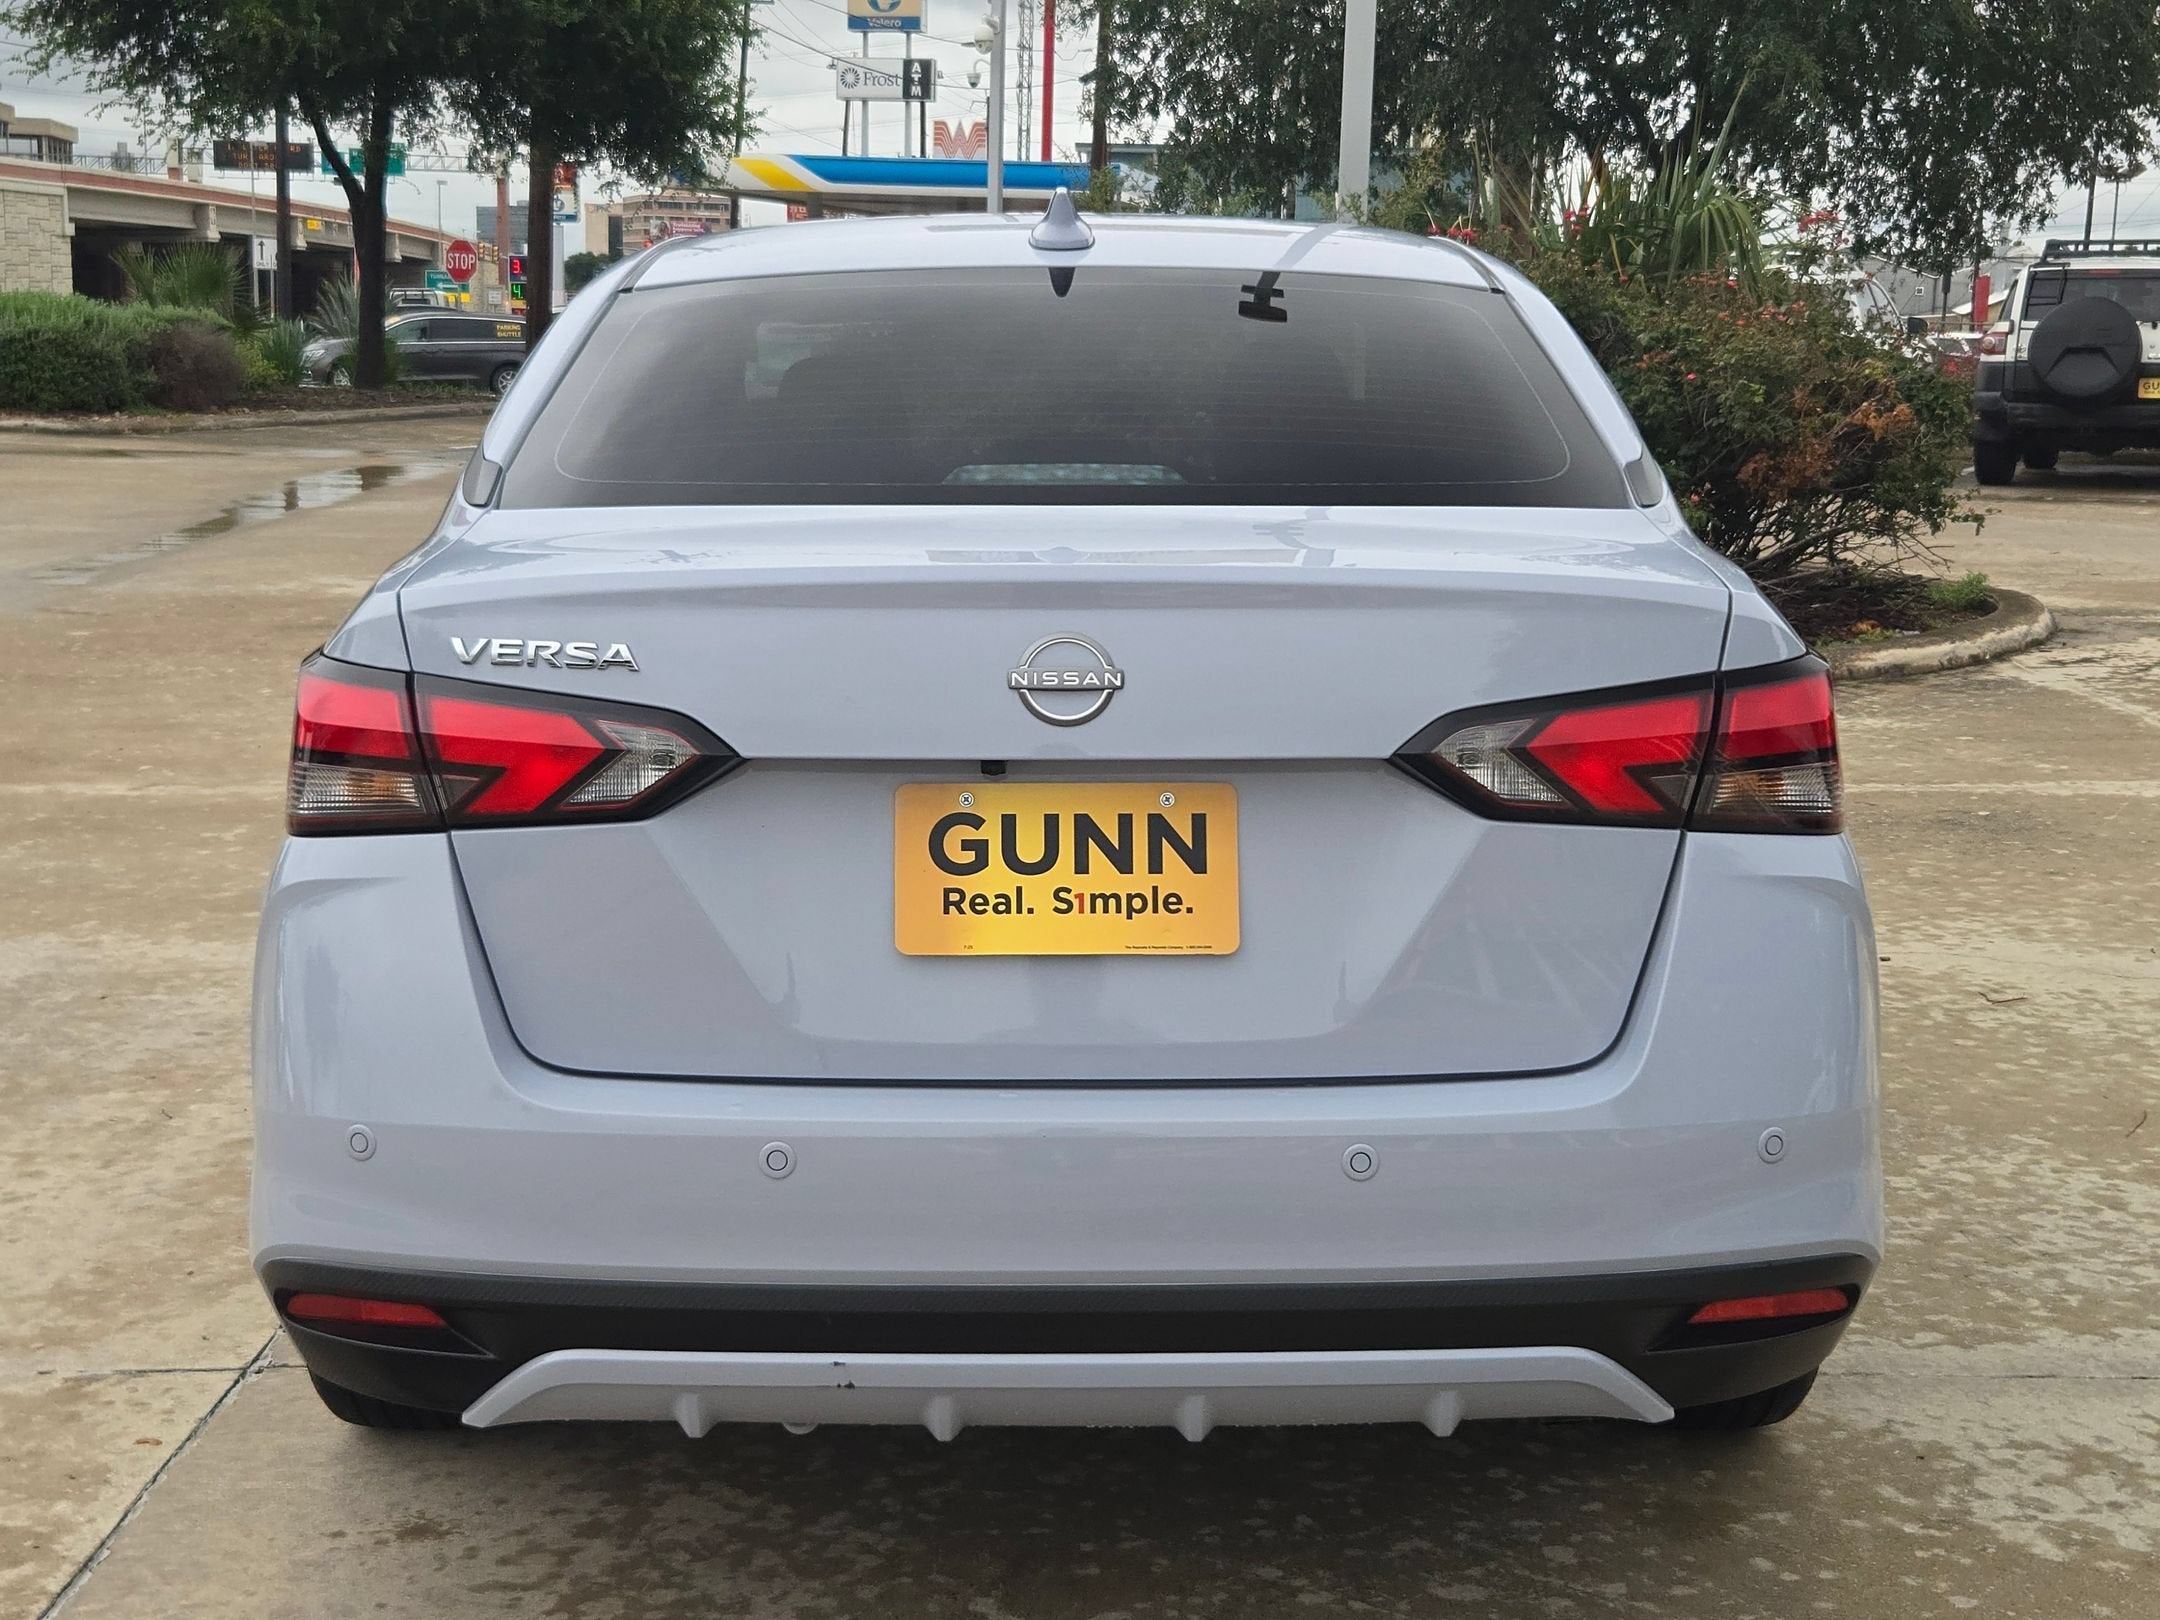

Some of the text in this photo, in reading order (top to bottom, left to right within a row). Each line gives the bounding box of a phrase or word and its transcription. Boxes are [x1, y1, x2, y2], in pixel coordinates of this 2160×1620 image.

[867, 18, 902, 29] Valero
[862, 71, 900, 87] Frost
[911, 62, 922, 97] ATM
[447, 253, 476, 270] STOP
[450, 636, 640, 672] VERSA
[1011, 672, 1121, 686] NISSAN
[928, 811, 1208, 876] GUNN
[942, 885, 1194, 920] Real. S1mple.
